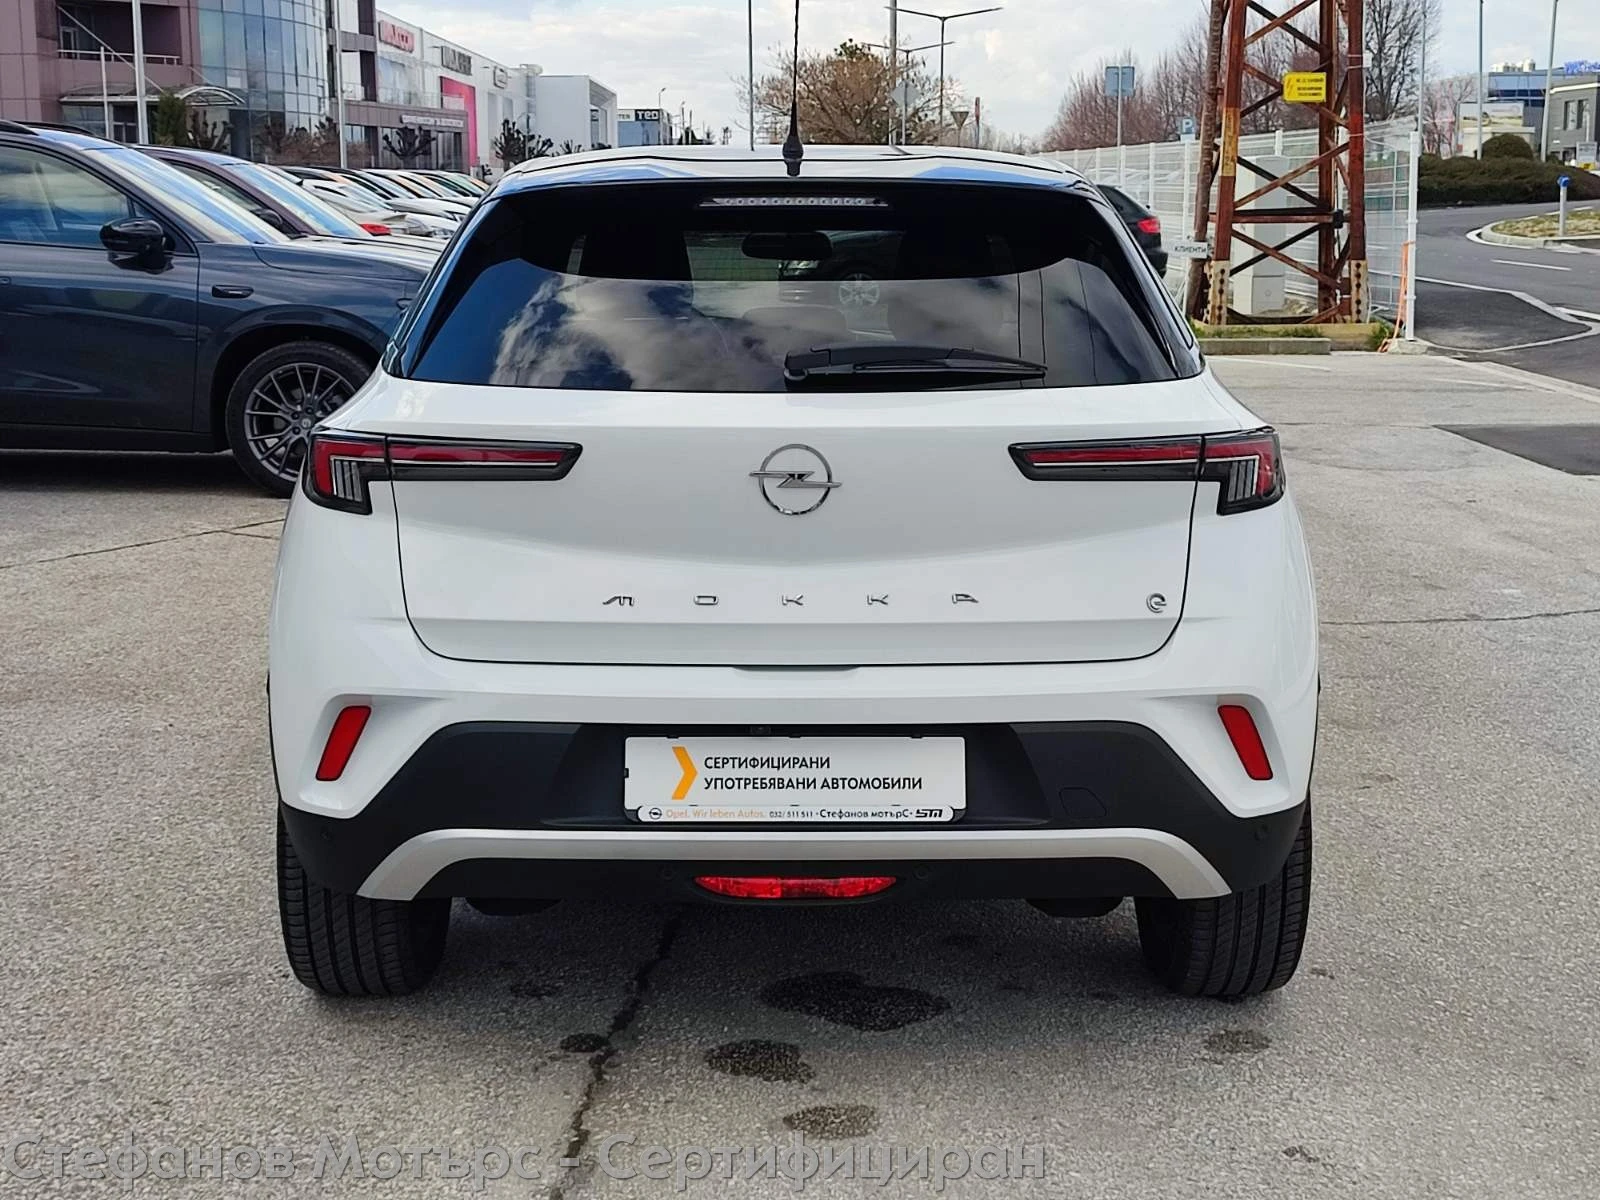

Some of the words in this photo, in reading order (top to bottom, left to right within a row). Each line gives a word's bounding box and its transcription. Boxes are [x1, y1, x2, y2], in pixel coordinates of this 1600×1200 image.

[1182, 118, 1194, 133] P
[703, 756, 831, 771] СЕРТИФИЦИРАНИ
[703, 777, 817, 790] УПОТРЕБЯВАНИ
[820, 777, 923, 790] АВТОМОБИЛИ
[709, 809, 736, 818] leben
